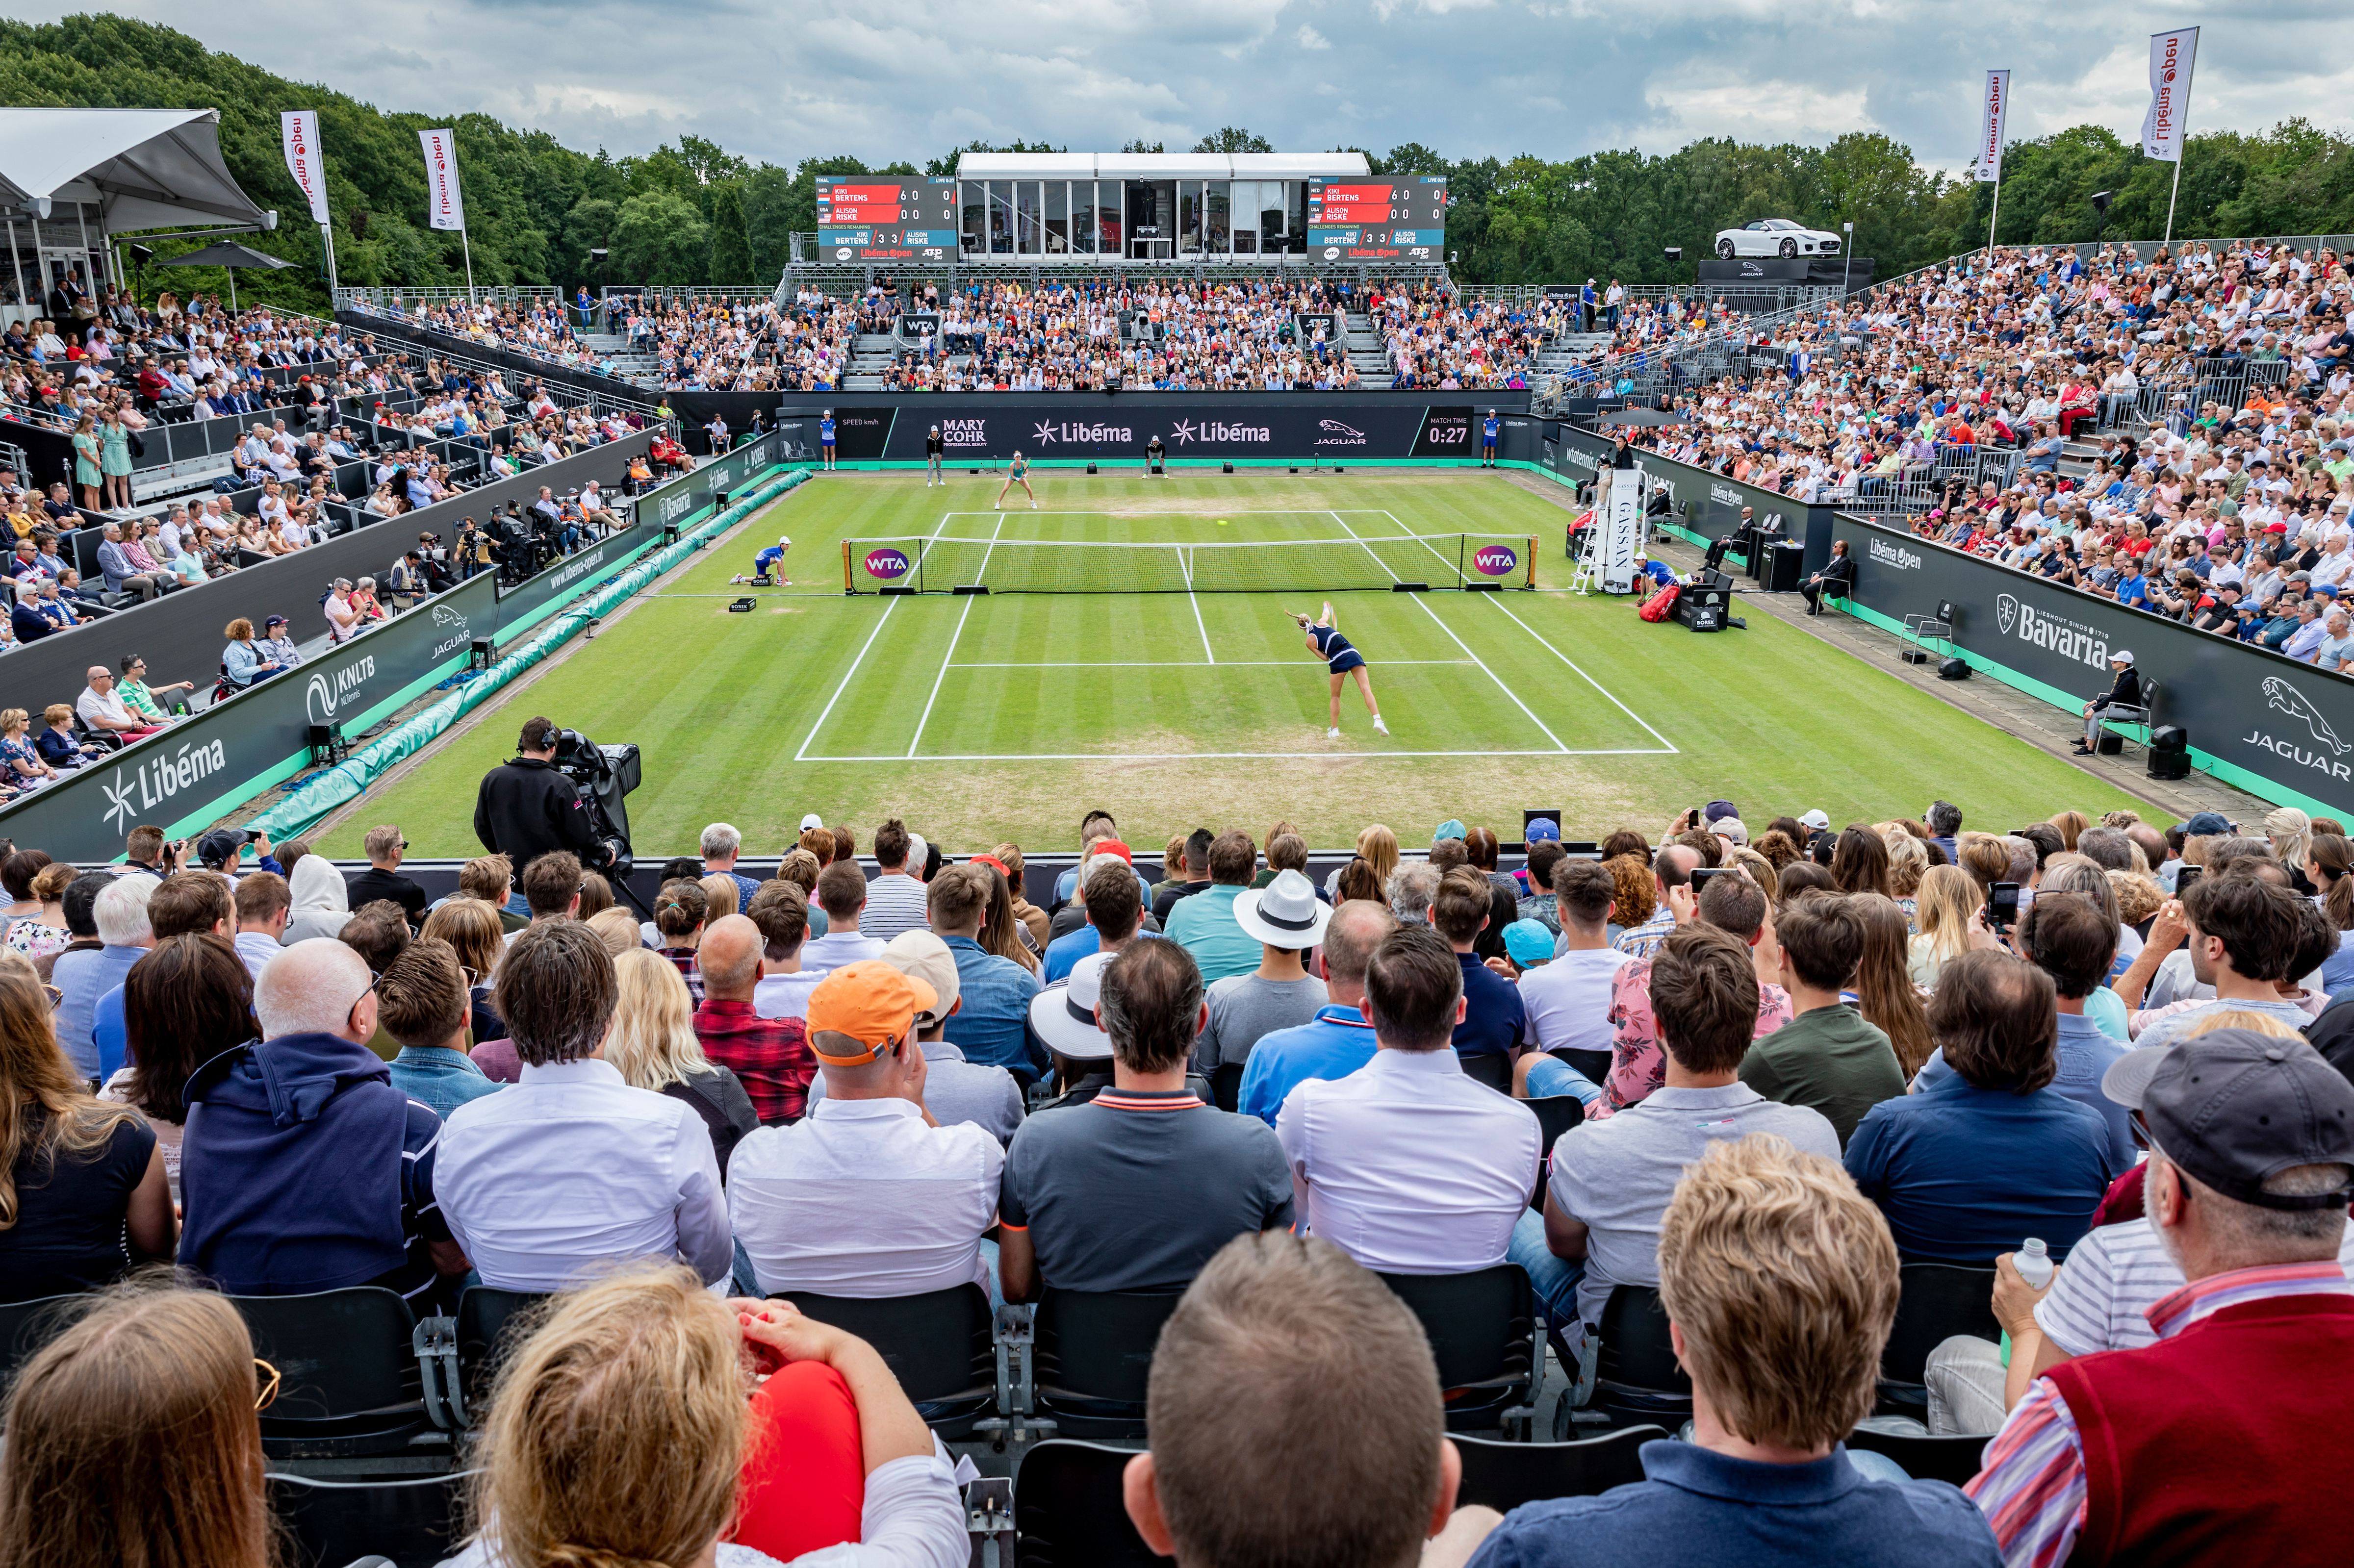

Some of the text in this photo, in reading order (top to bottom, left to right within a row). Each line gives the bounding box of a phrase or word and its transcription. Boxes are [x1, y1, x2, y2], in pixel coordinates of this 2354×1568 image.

[900, 190, 949, 201] 6 0 0
[1392, 189, 1440, 200] 6 0 0
[901, 210, 950, 220] 0 0 0
[1391, 209, 1439, 219] 0 0 0
[878, 234, 885, 243] 3
[891, 234, 897, 243] 3
[1366, 233, 1373, 243] 3
[1379, 233, 1385, 243] 3
[861, 249, 912, 259] Libéma Open
[1376, 248, 1399, 258] Open
[907, 321, 935, 330] WTA
[1305, 319, 1330, 328] ATP
[944, 420, 986, 430] MARY
[944, 431, 986, 442] COHR
[1062, 423, 1132, 442] Libéma
[1201, 422, 1270, 441] Libéma
[1430, 428, 1466, 443] 0:27
[751, 444, 766, 467] BOREK
[1543, 458, 1555, 467] JAGUAR
[714, 467, 729, 489] Libéma
[1711, 483, 1727, 501] Libéma
[1727, 489, 1742, 506] Open
[667, 492, 691, 520] Bavaria
[1615, 502, 1631, 569] GASSAN
[1870, 537, 1921, 570] Libéma Open
[867, 558, 906, 570] WTA
[1476, 555, 1513, 567] WTA
[550, 546, 603, 589] www.libema-open.nl
[1681, 609, 1691, 619] BOREK
[2037, 609, 2109, 639] LIESHOUT SINDS 1719
[2019, 604, 2107, 671] Bavaria
[432, 630, 470, 659] JAGUAR
[337, 655, 375, 691] KNLTB
[340, 688, 360, 707] NLTennis
[2243, 731, 2351, 783] JAGUAR
[138, 738, 226, 810] Libéma
